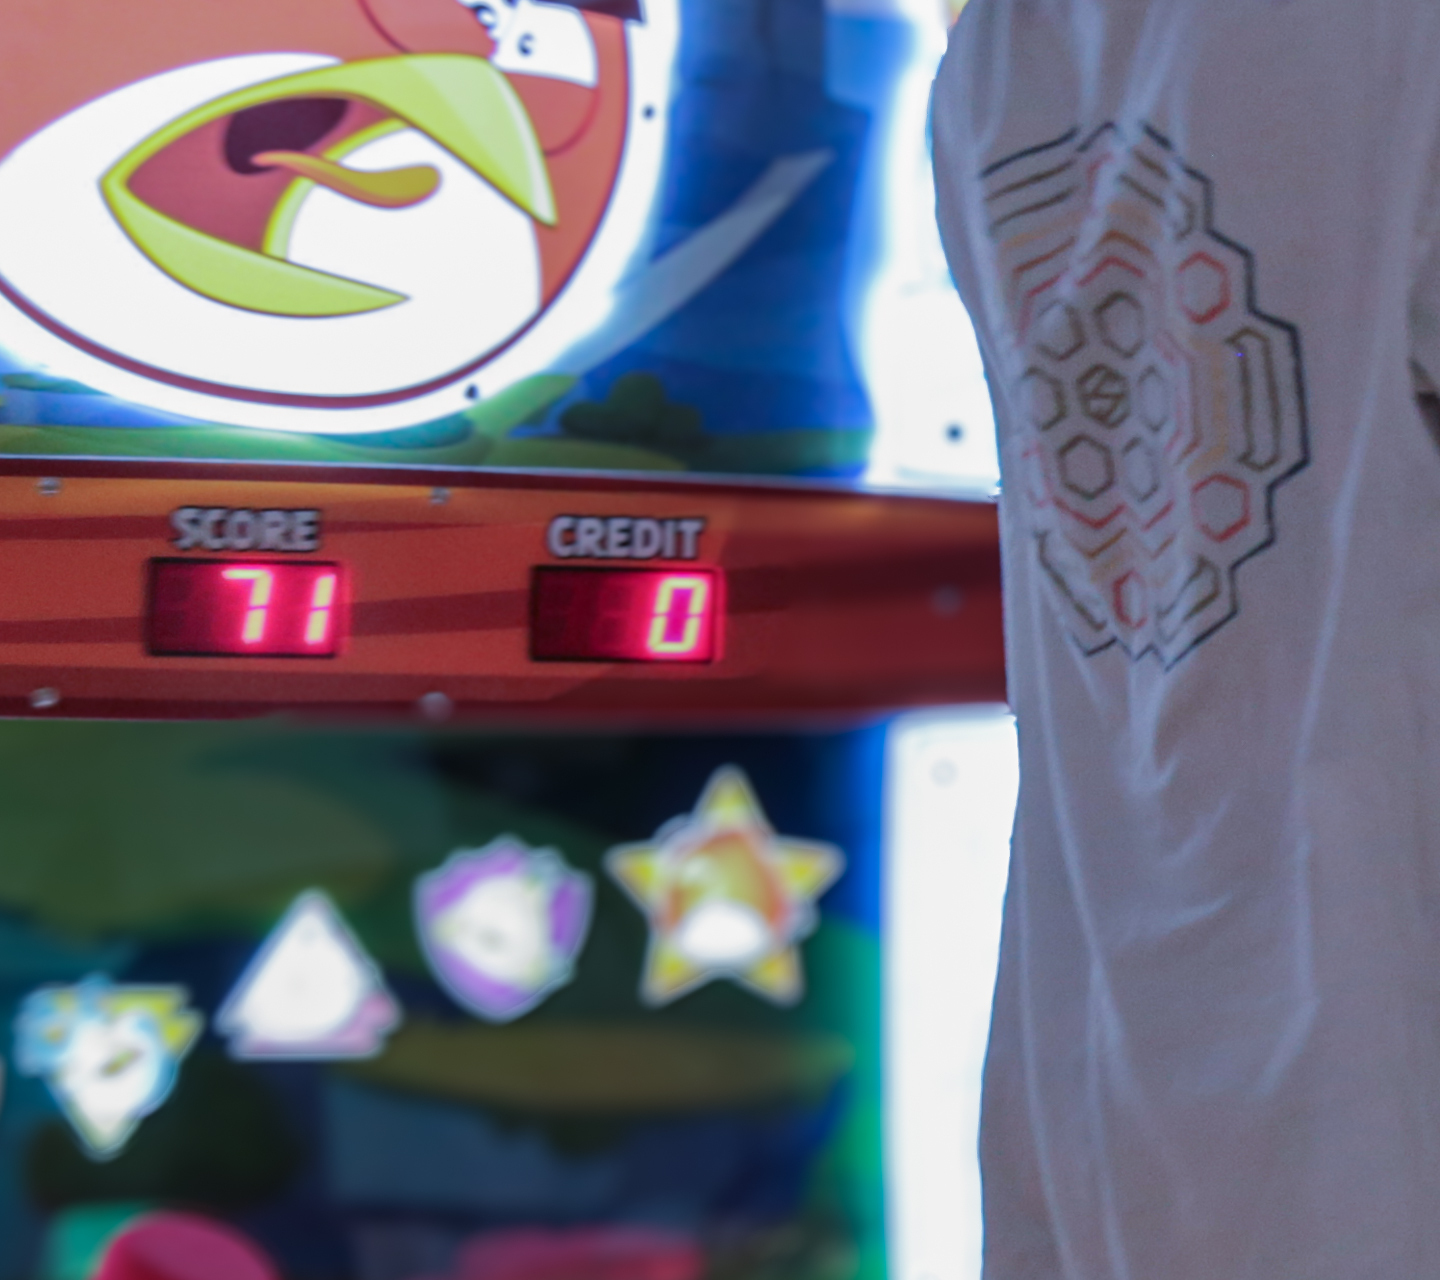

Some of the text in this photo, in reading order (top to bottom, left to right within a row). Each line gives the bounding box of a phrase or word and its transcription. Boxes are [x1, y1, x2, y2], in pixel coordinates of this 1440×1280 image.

[169, 506, 320, 552] SCORE
[546, 515, 706, 560] CREDIT
[221, 567, 337, 645] 71
[646, 576, 710, 654] 0
